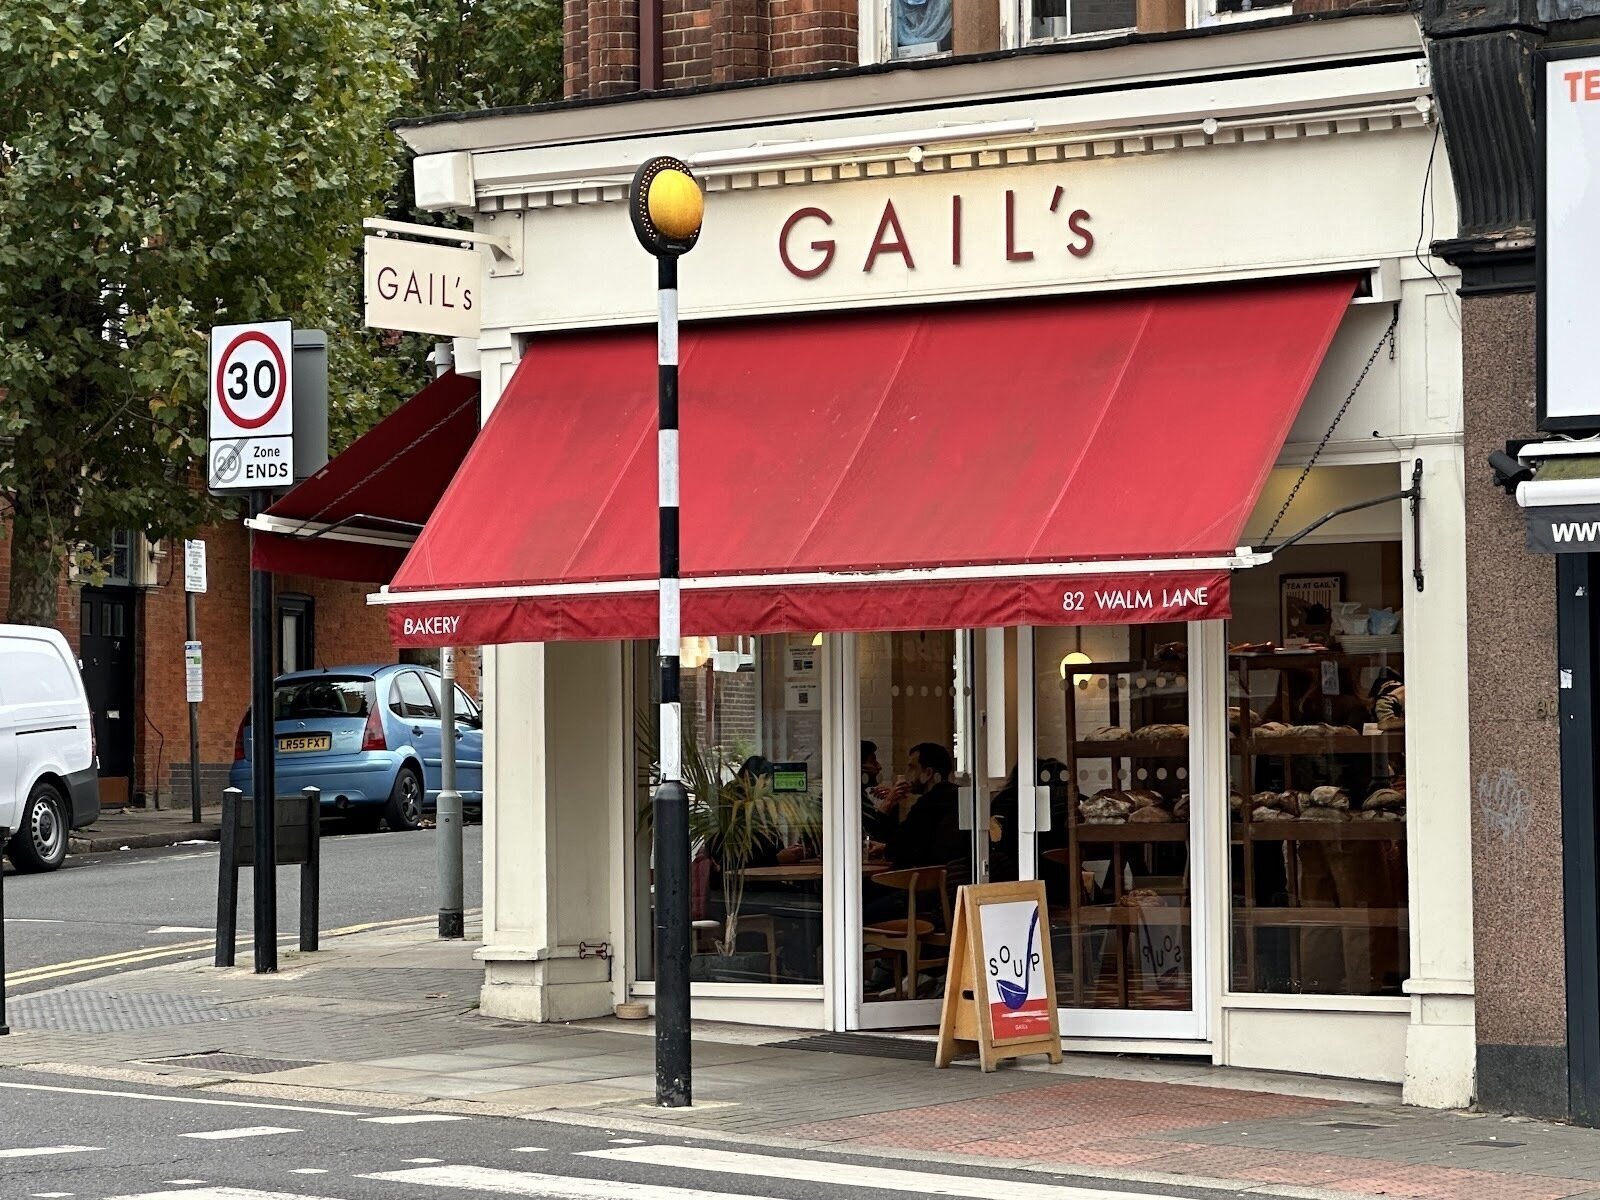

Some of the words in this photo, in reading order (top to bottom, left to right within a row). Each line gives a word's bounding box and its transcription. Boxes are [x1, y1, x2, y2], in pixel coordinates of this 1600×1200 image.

[779, 185, 1094, 279] GAIL's
[377, 266, 473, 311] GAIL's
[227, 359, 276, 401] 30
[253, 446, 281, 458] Zone
[246, 462, 288, 479] ENDS
[1062, 591, 1085, 611] 82
[1094, 589, 1153, 610] WALM
[1162, 586, 1209, 608] LANE
[403, 615, 460, 635] BAKERY
[280, 738, 305, 750] LR55
[307, 737, 327, 748] FXT
[990, 945, 1040, 977] SOUP
